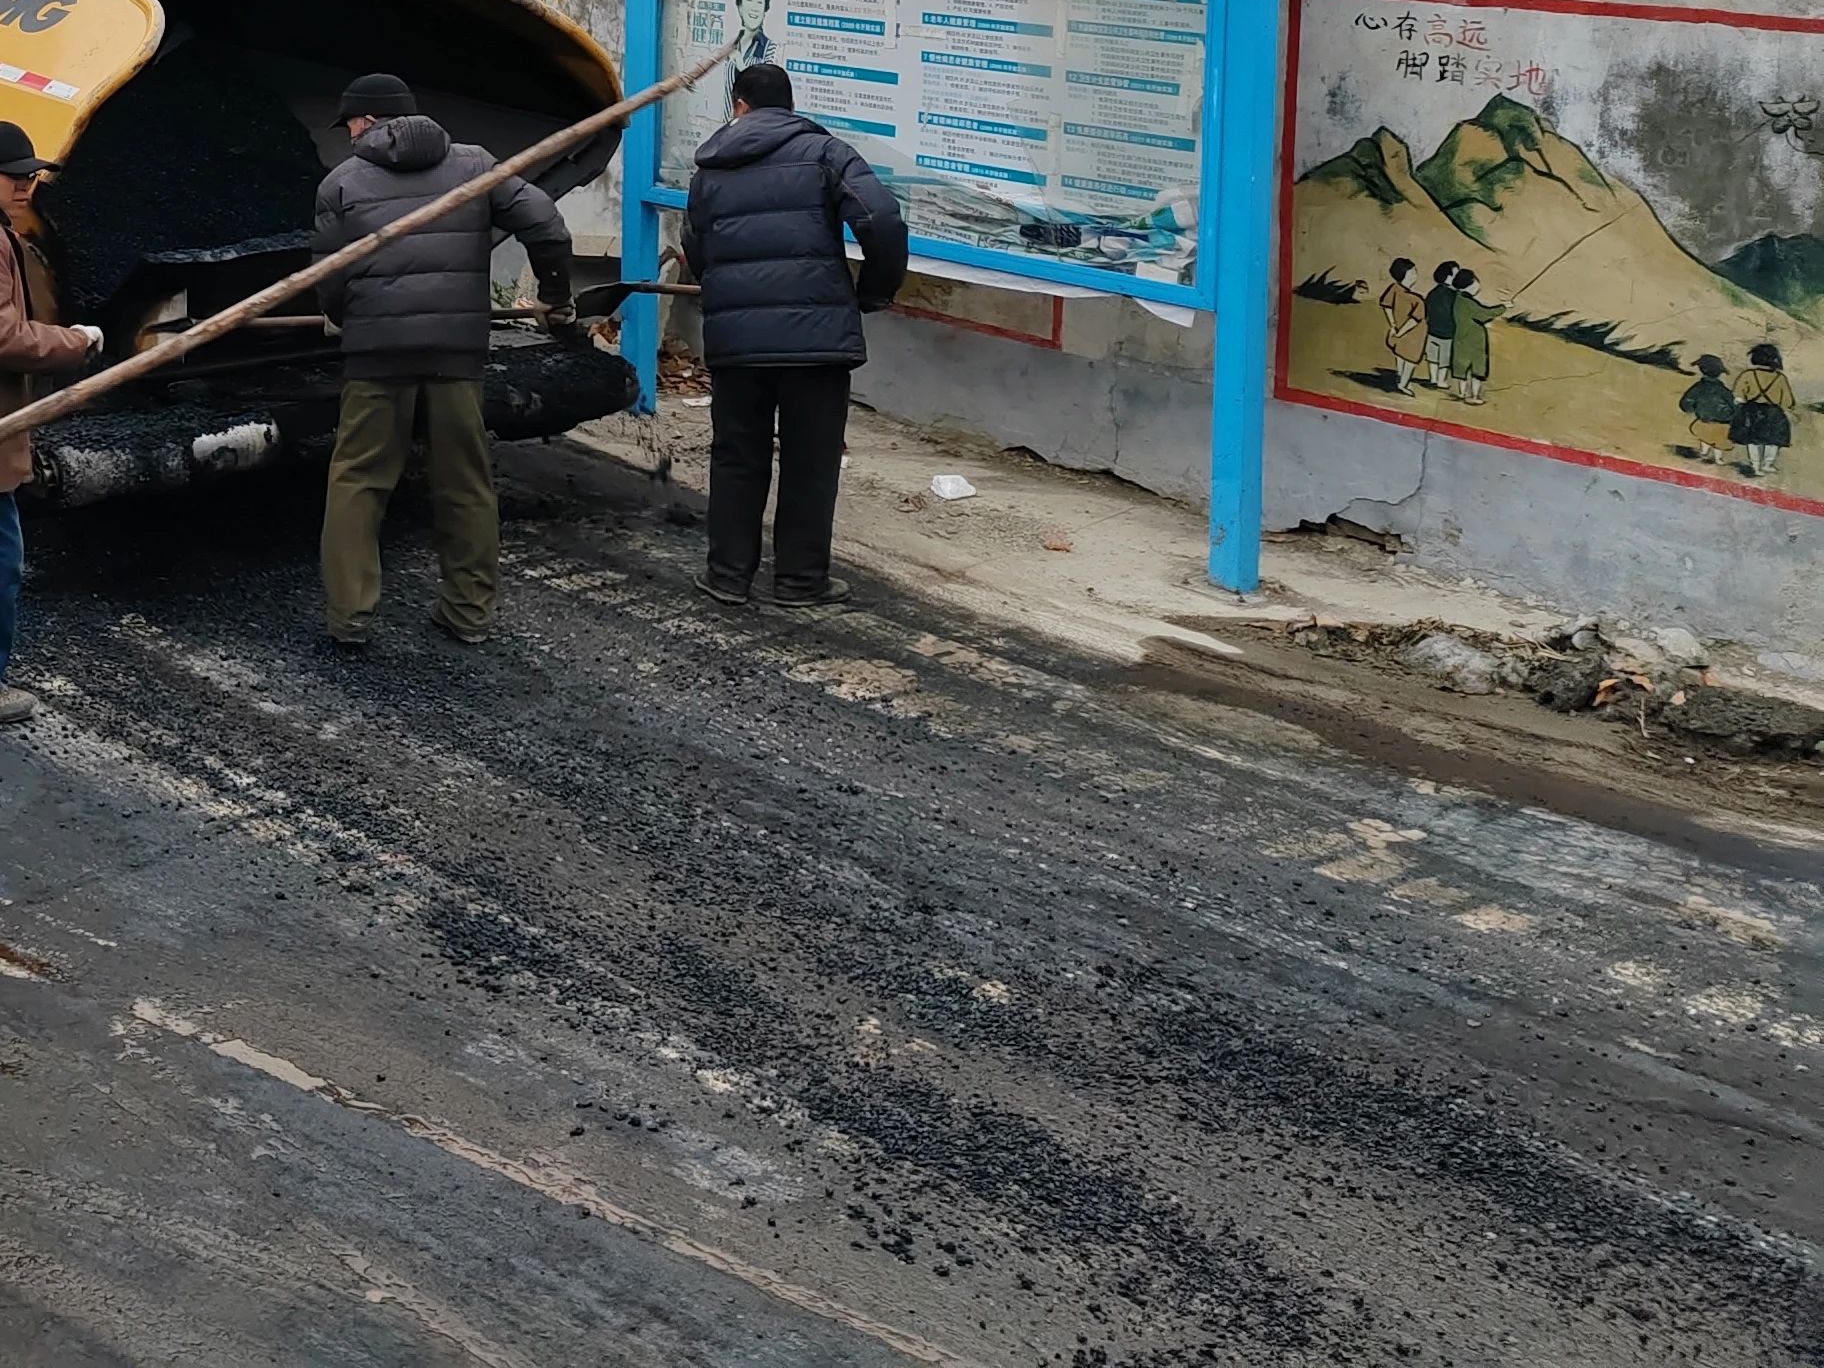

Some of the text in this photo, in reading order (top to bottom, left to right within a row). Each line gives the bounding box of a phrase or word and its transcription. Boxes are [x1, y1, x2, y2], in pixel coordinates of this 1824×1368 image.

[1354, 10, 1492, 52] 心存高远
[1395, 49, 1547, 96] 脚踏实地
